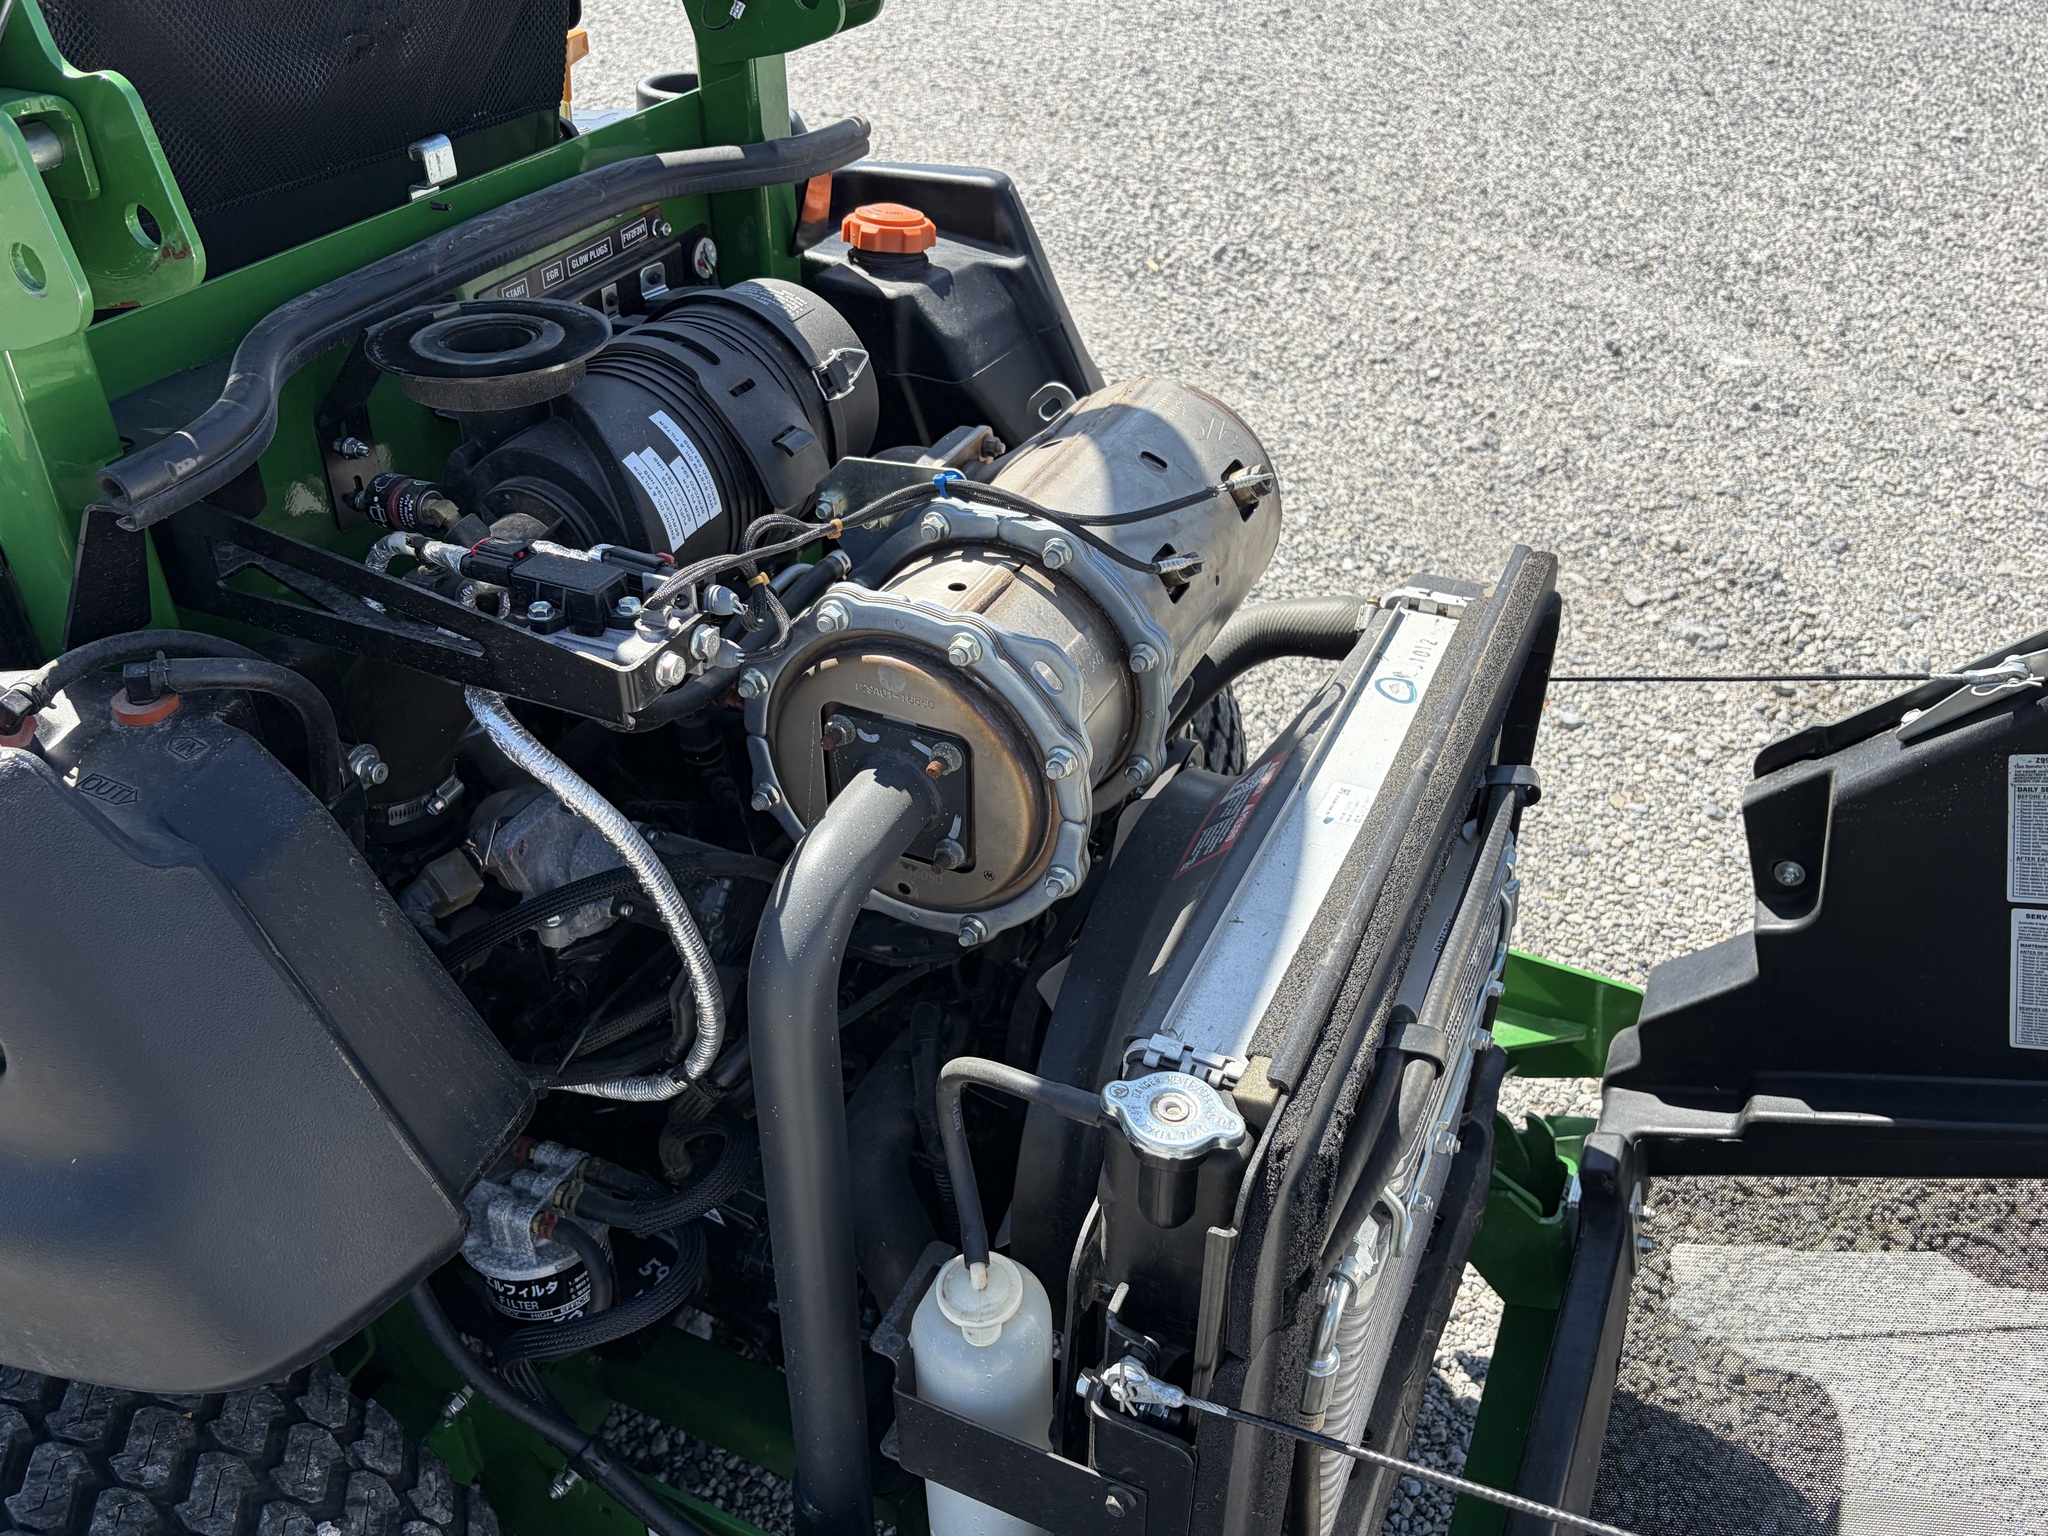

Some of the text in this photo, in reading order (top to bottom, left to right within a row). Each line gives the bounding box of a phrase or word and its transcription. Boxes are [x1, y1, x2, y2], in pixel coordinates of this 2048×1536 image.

[571, 244, 608, 269] GLOW PLUGS
[546, 268, 559, 281] EGR
[505, 284, 525, 297] START
[659, 420, 680, 442] FILTER
[683, 439, 695, 454] HRS
[685, 449, 693, 462] OIL
[653, 457, 665, 472] HRS
[633, 466, 652, 490] FILTER
[643, 470, 655, 485] HRS
[693, 463, 709, 492] SYSTEM
[702, 469, 718, 506] SERVICED
[661, 476, 687, 526] FUEL FILTERS
[683, 478, 697, 504] FILTER
[657, 498, 665, 511] OIL
[674, 486, 691, 522] SERVICED
[663, 500, 680, 537] SERVICED
[663, 513, 676, 540] ENGINE
[81, 777, 133, 800] OUT
[499, 1296, 540, 1310] FILTER
[530, 1311, 553, 1319] HIGH
